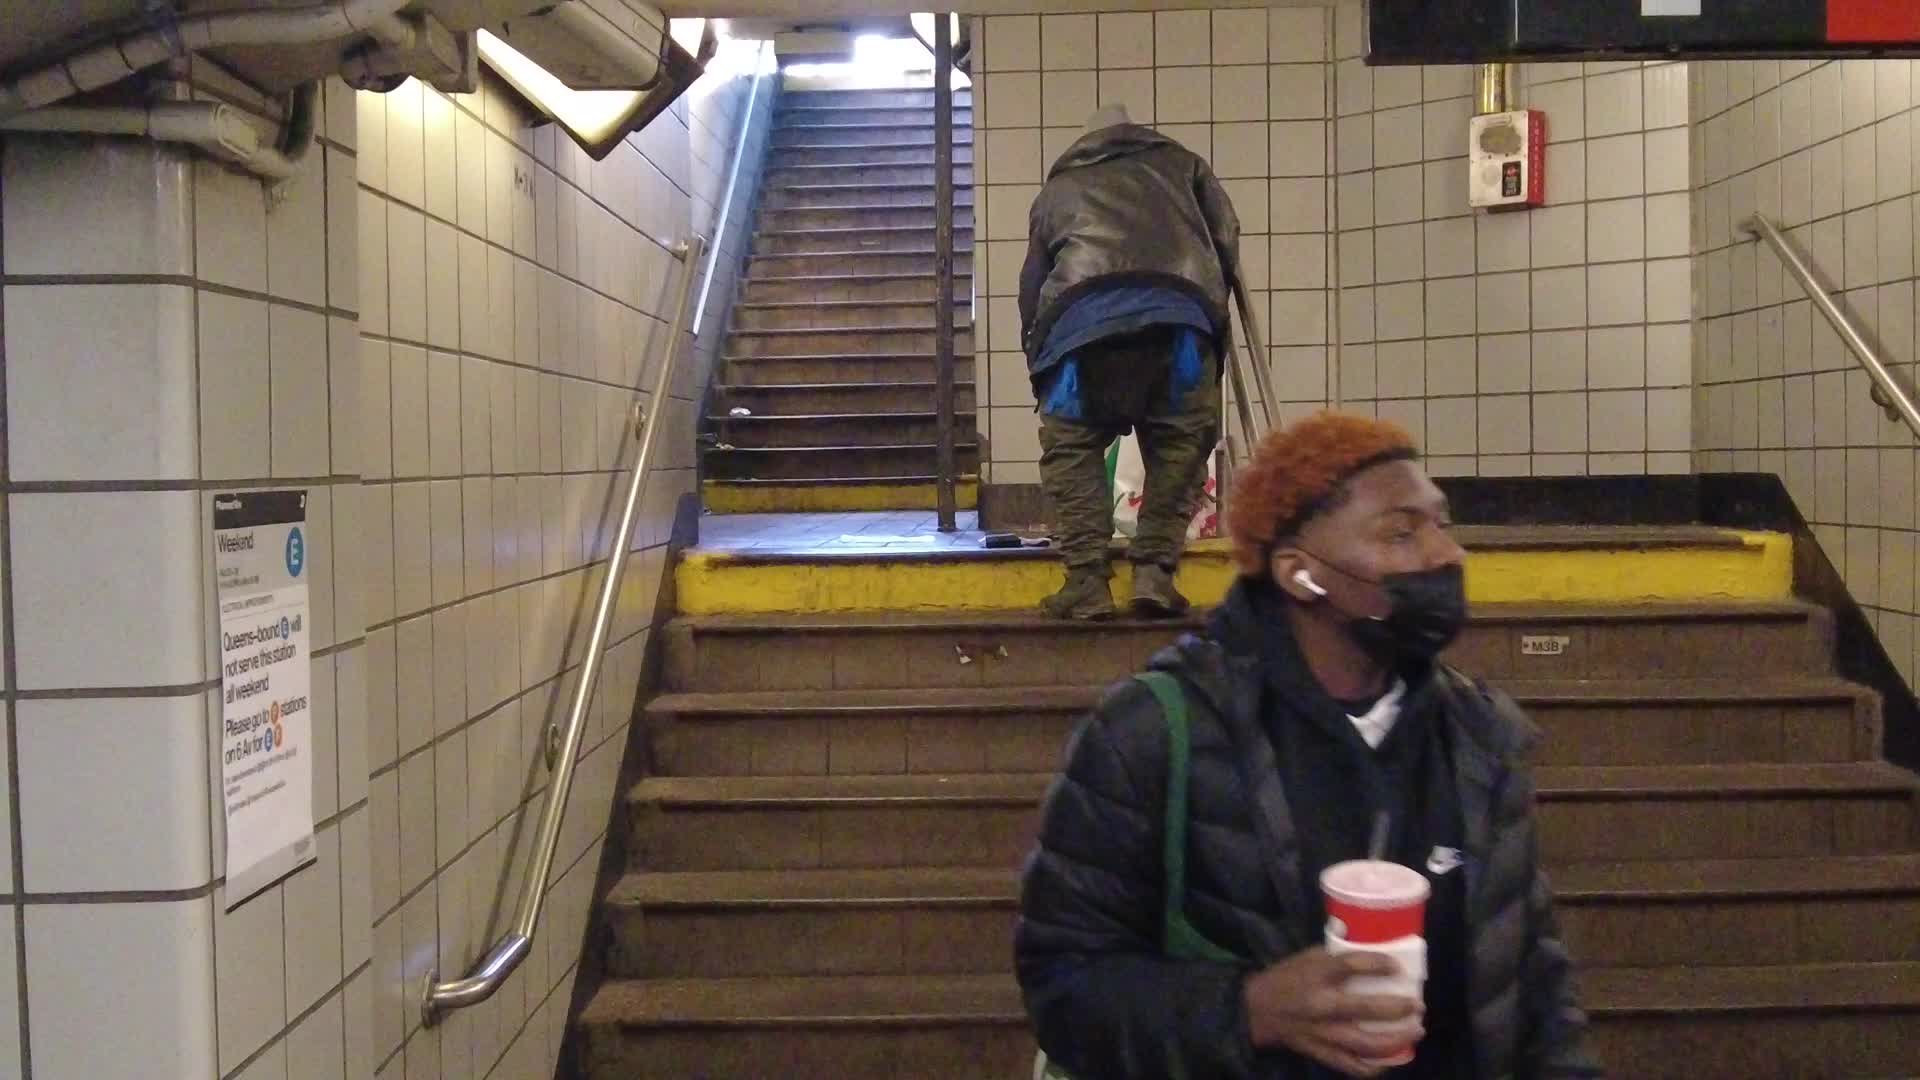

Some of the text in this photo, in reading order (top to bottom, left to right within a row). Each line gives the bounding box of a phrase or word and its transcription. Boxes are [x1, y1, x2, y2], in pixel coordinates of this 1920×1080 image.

[218, 532, 254, 552] Weekend
[224, 621, 280, 652] Queens-bound
[291, 614, 301, 632] will
[1532, 641, 1559, 652] M3B
[226, 644, 296, 677] not serve this station
[226, 674, 269, 704] all weekend
[226, 716, 251, 738] Please
[251, 712, 261, 732] go
[262, 707, 269, 724] to
[281, 696, 306, 717] stations
[225, 748, 235, 765] on
[236, 742, 241, 760] 6
[243, 738, 251, 757] Av
[253, 735, 263, 753] for
